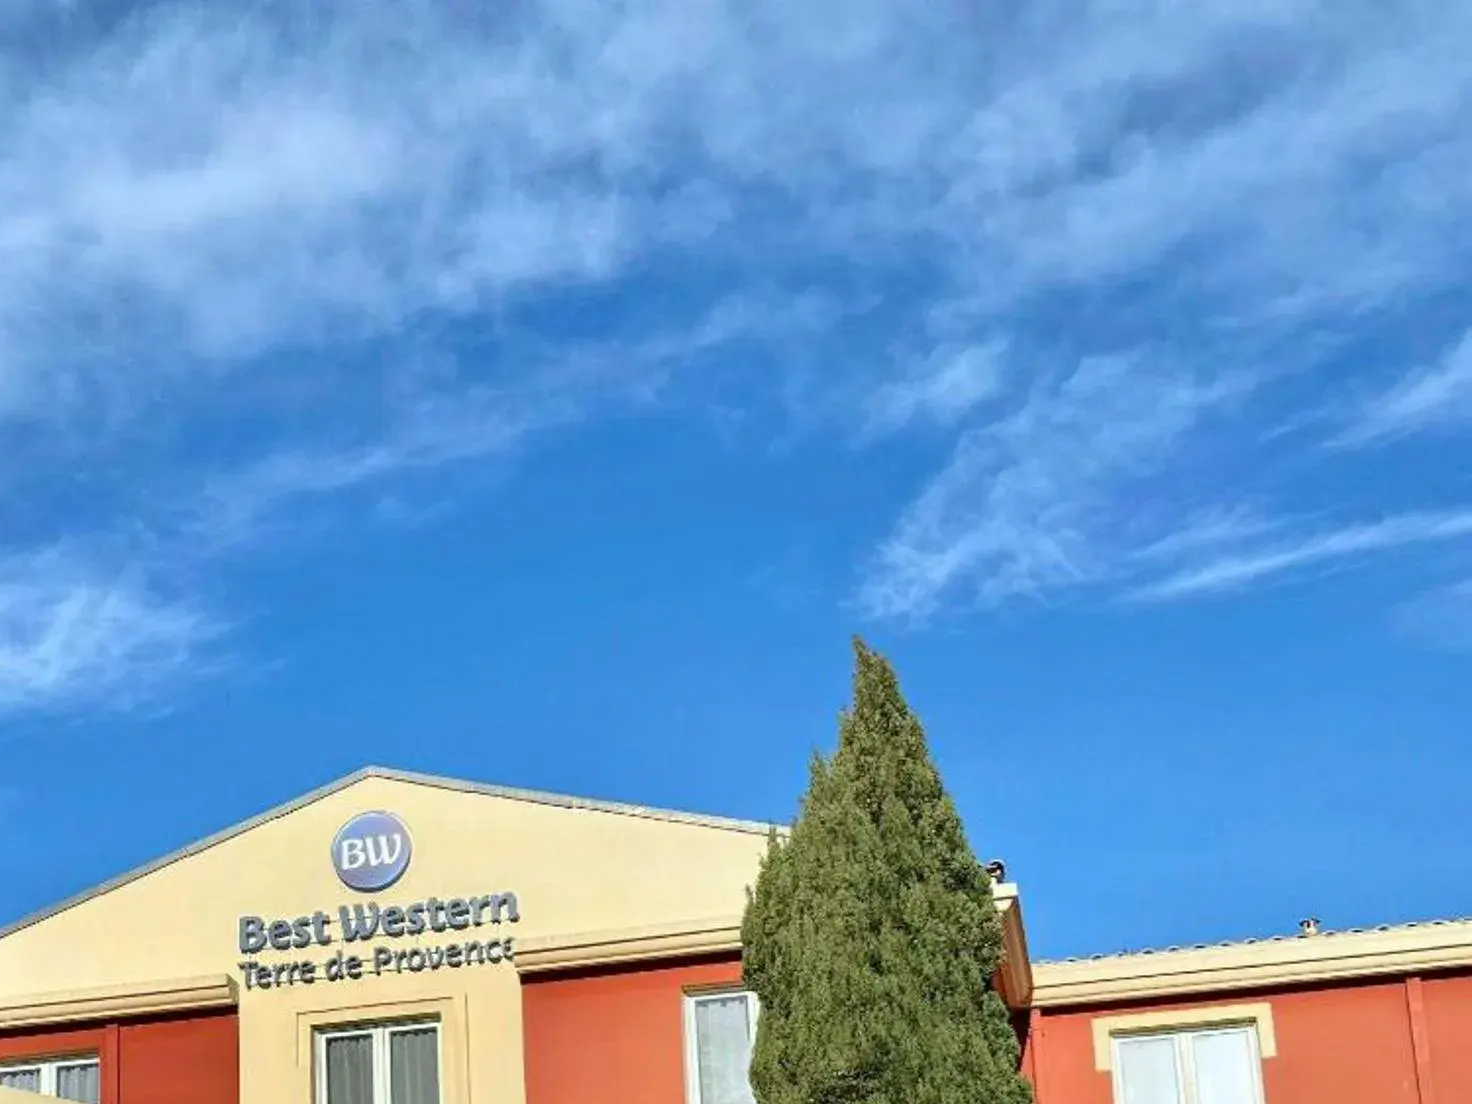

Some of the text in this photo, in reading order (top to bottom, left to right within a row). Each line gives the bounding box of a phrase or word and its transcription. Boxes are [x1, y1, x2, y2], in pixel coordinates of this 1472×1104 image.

[340, 833, 403, 870] BW
[238, 890, 521, 955] Best Western
[238, 957, 317, 991] Terre
[327, 950, 363, 983] de
